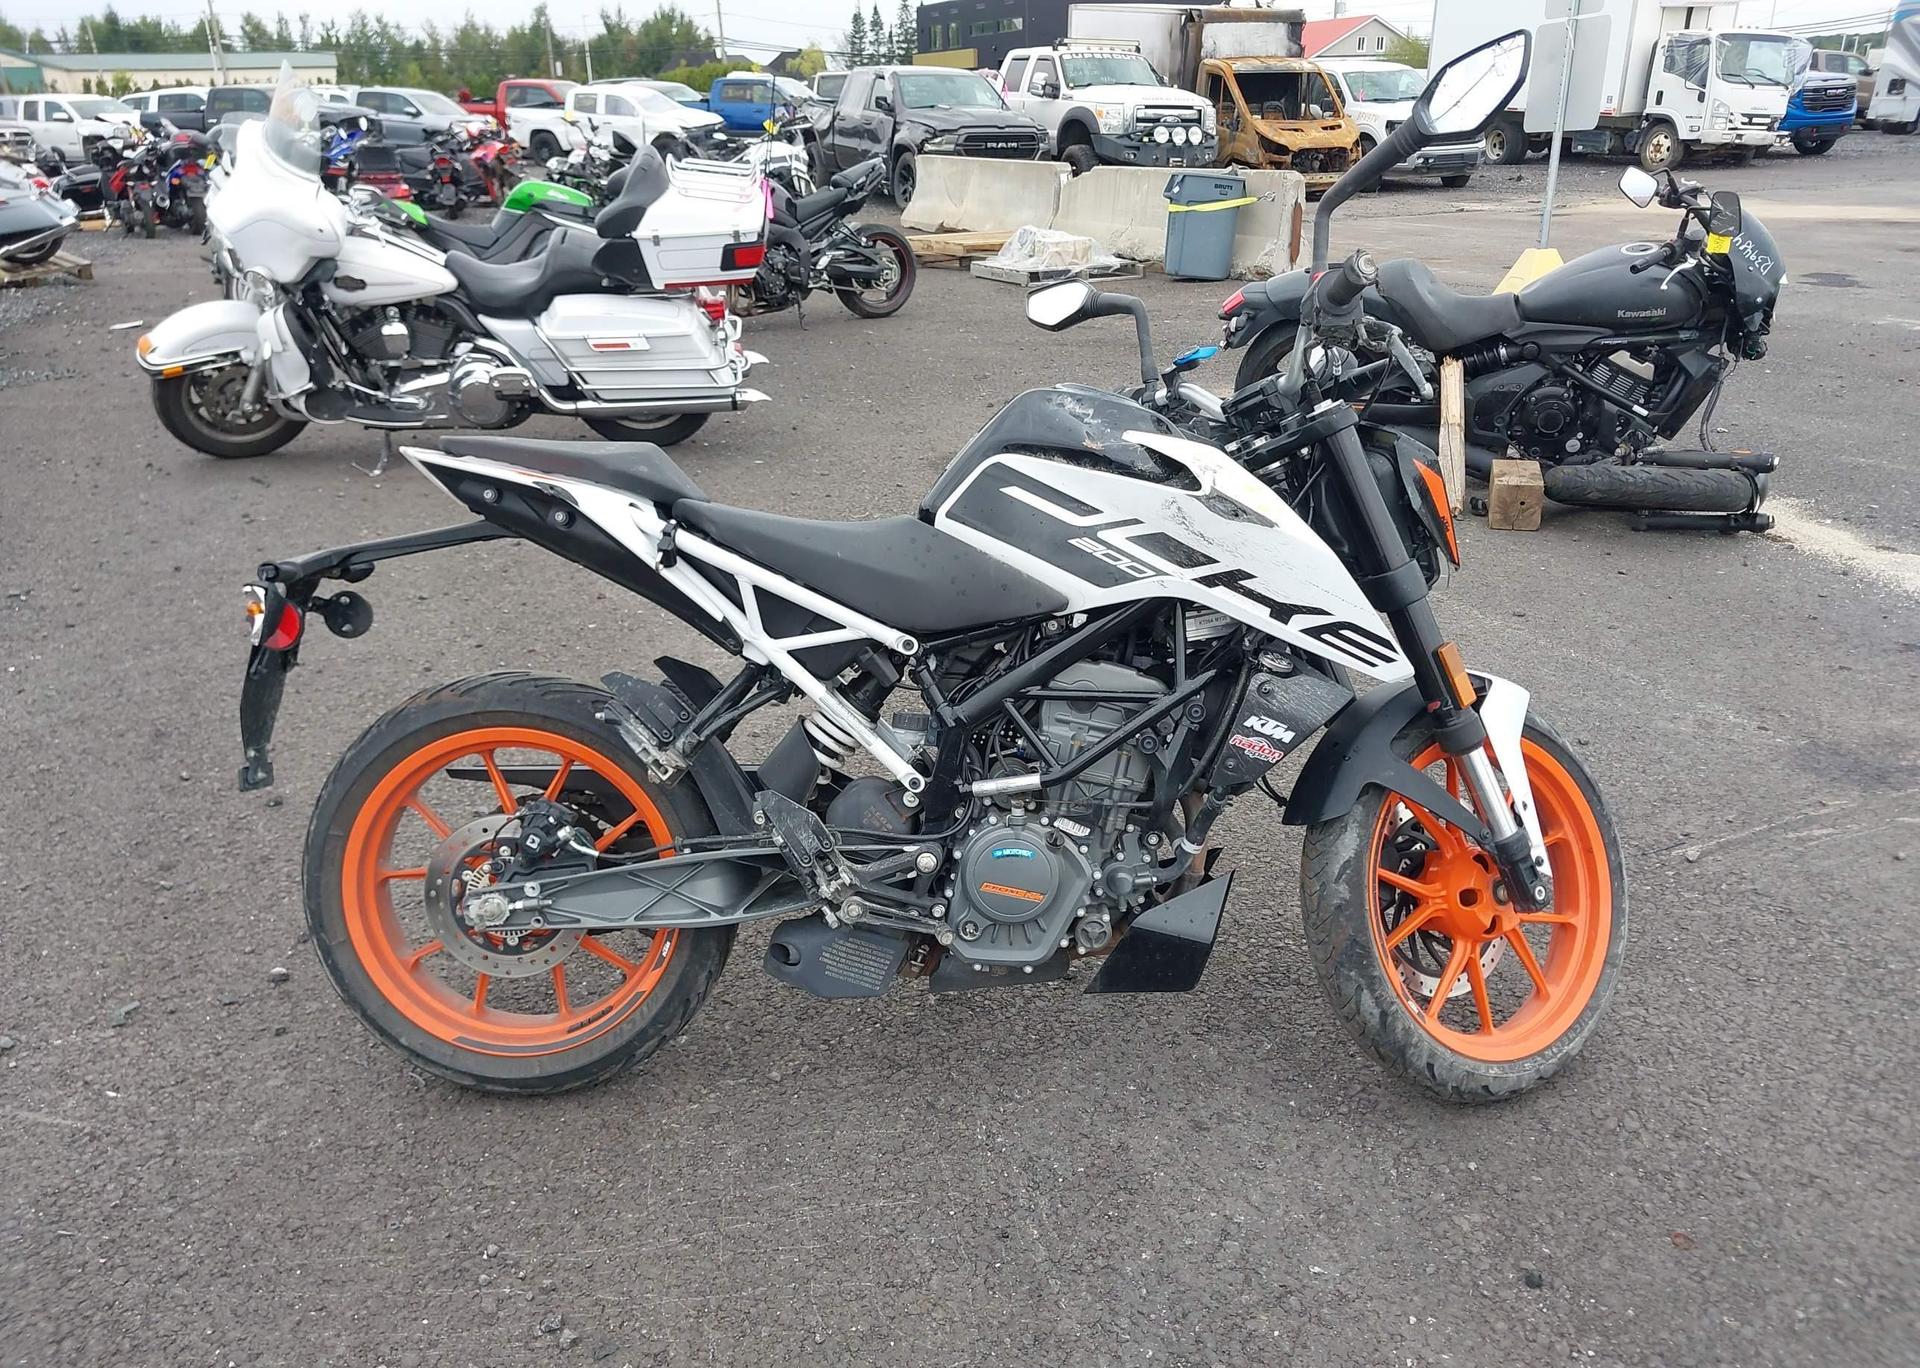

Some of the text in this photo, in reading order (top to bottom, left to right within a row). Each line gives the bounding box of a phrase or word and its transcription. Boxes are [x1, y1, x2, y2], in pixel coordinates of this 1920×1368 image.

[1617, 307, 1667, 318] Kawasaki
[1066, 536, 1160, 579] 200
[1243, 715, 1296, 744] KTM
